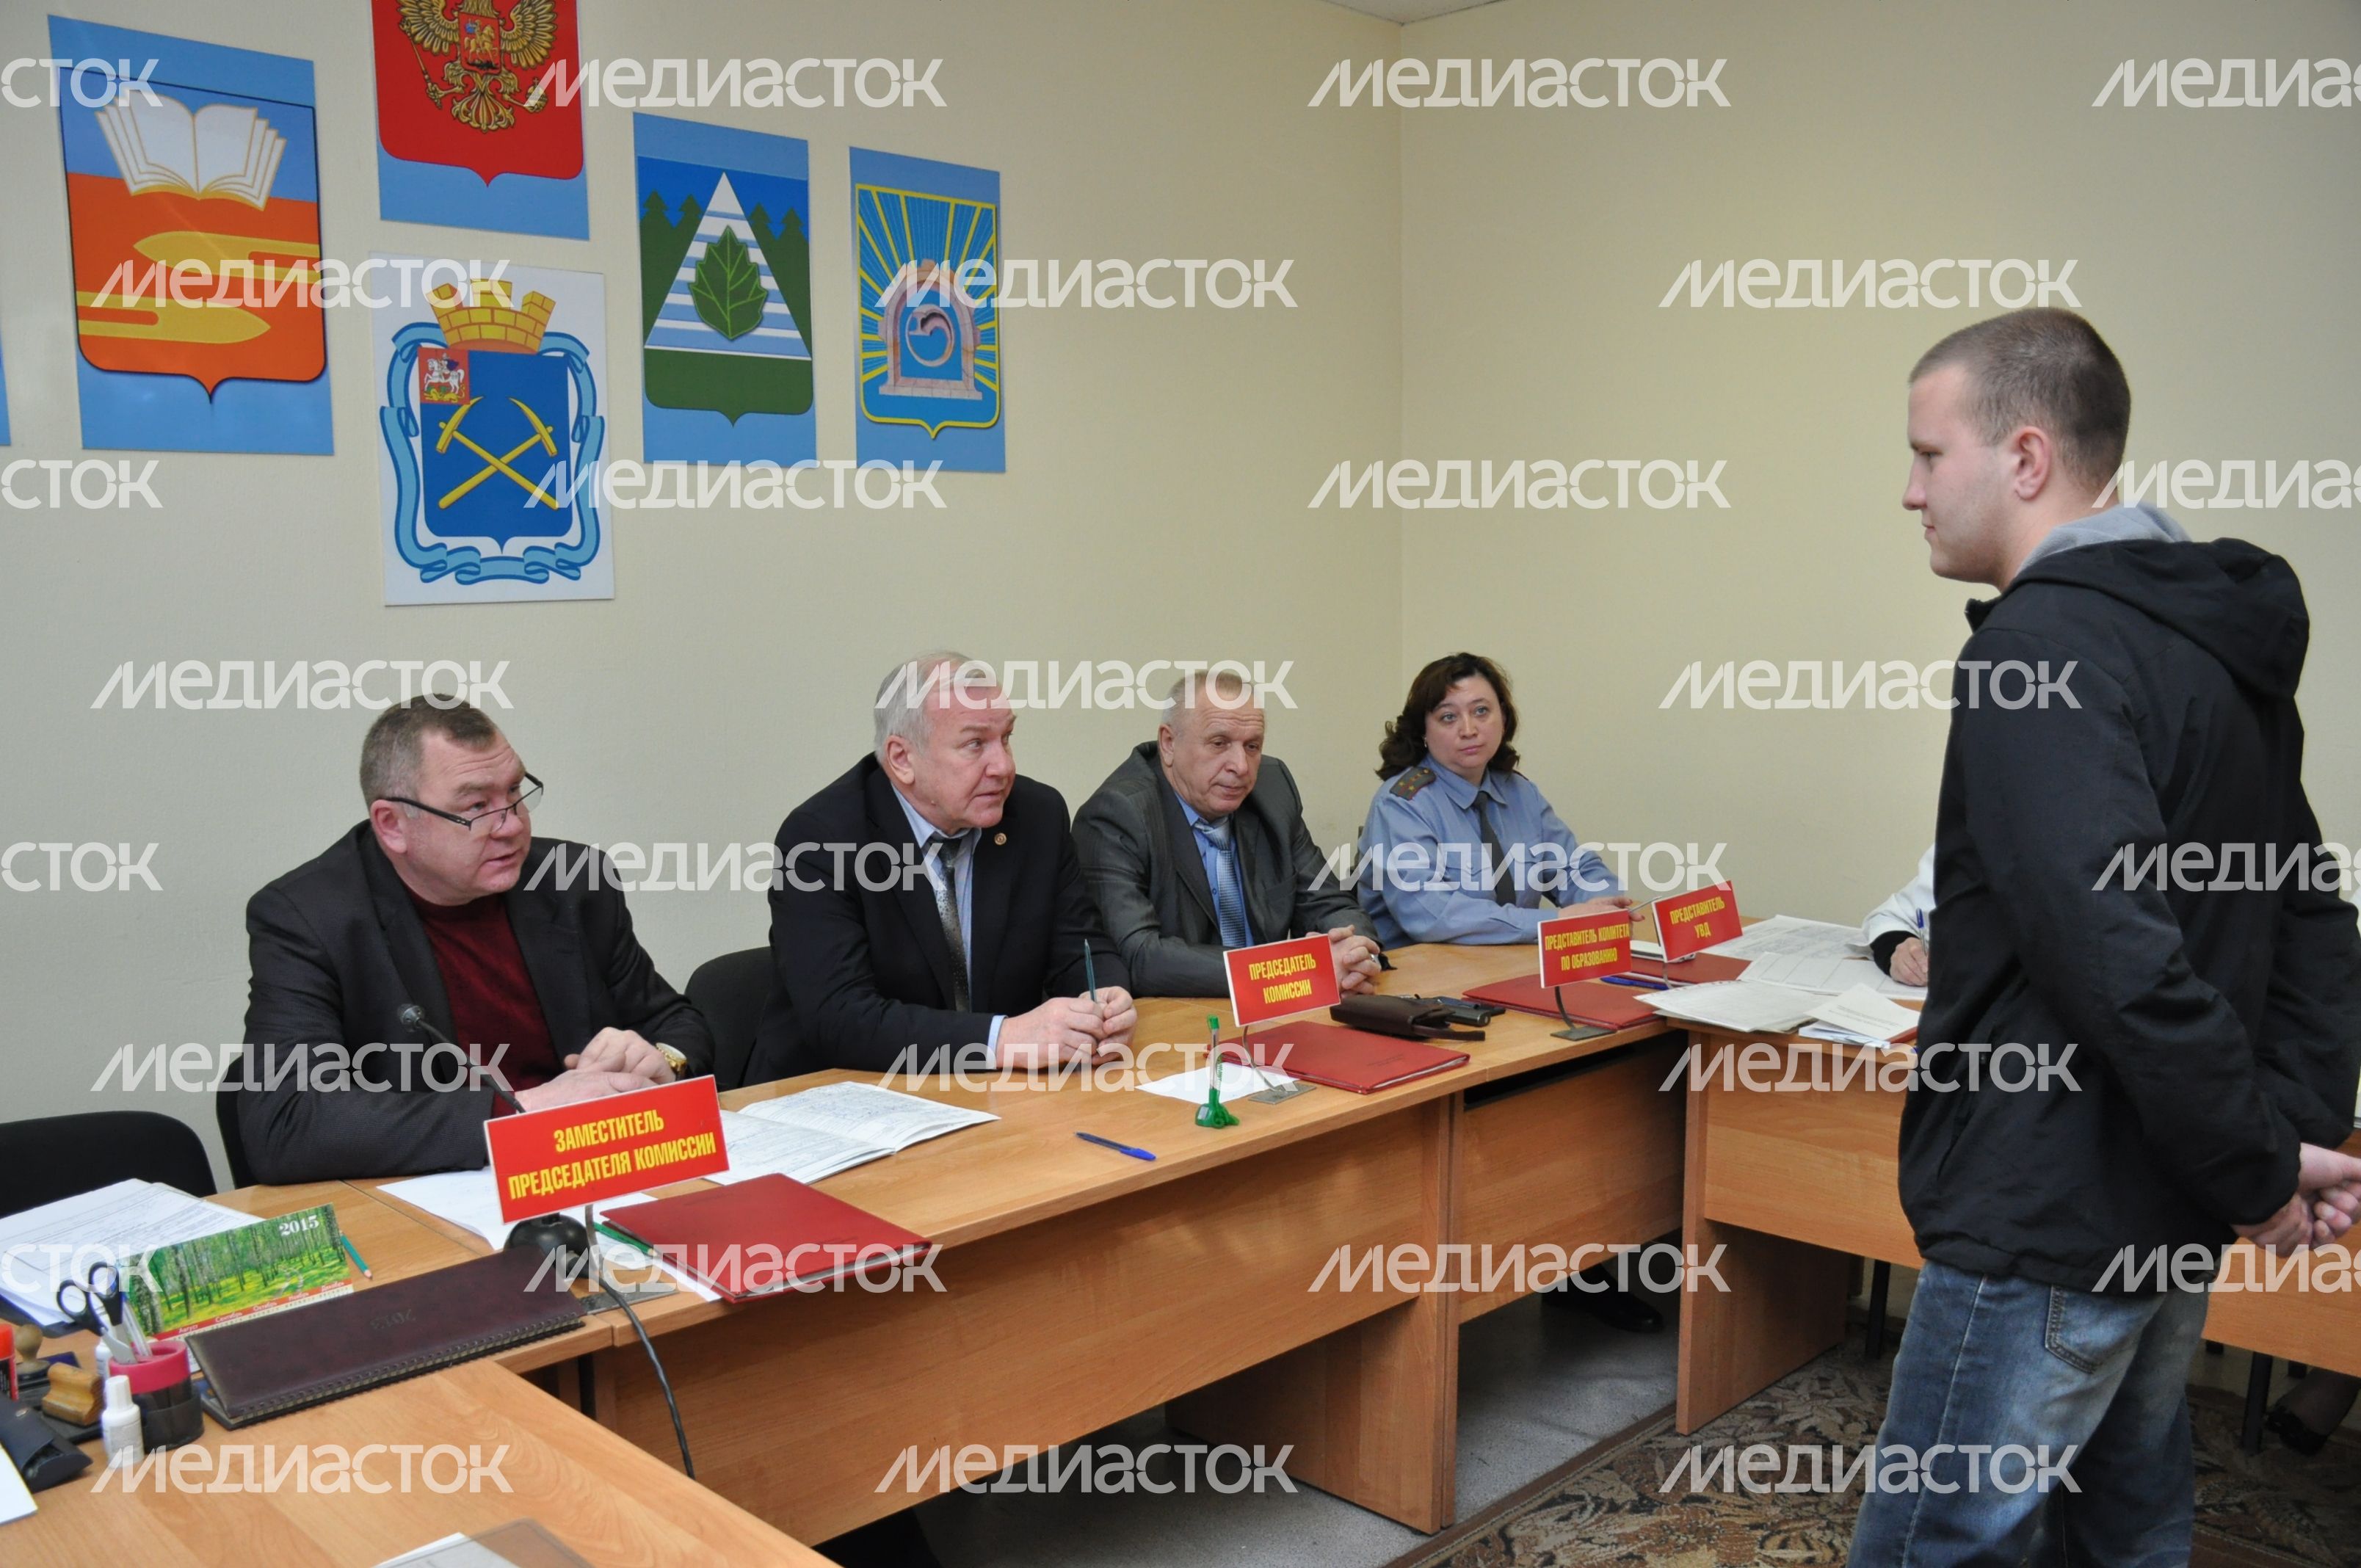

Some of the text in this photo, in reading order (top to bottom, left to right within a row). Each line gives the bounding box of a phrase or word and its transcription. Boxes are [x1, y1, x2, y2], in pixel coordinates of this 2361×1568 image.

[1669, 896, 1725, 925] ПРЕДСТАВИТЕЛЬ
[1545, 923, 1630, 951] ПРЕДСТАВИТЕЛЬ КОМИТЕТА
[1694, 922, 1711, 938] УВД
[1249, 953, 1316, 981] ПРЕДСЕДАТЕЛЬ
[1561, 947, 1618, 971] ПО ОБРАЗОВАНИЮ
[1263, 979, 1313, 1004] КОМИССИИ
[554, 1109, 664, 1153] ЗАМЕСТИТЕЛЬ
[508, 1150, 631, 1199] ПРЕДСЕДАТЕЛЯ
[634, 1132, 717, 1171] КОМИССИИ
[279, 1215, 319, 1237] 2015
